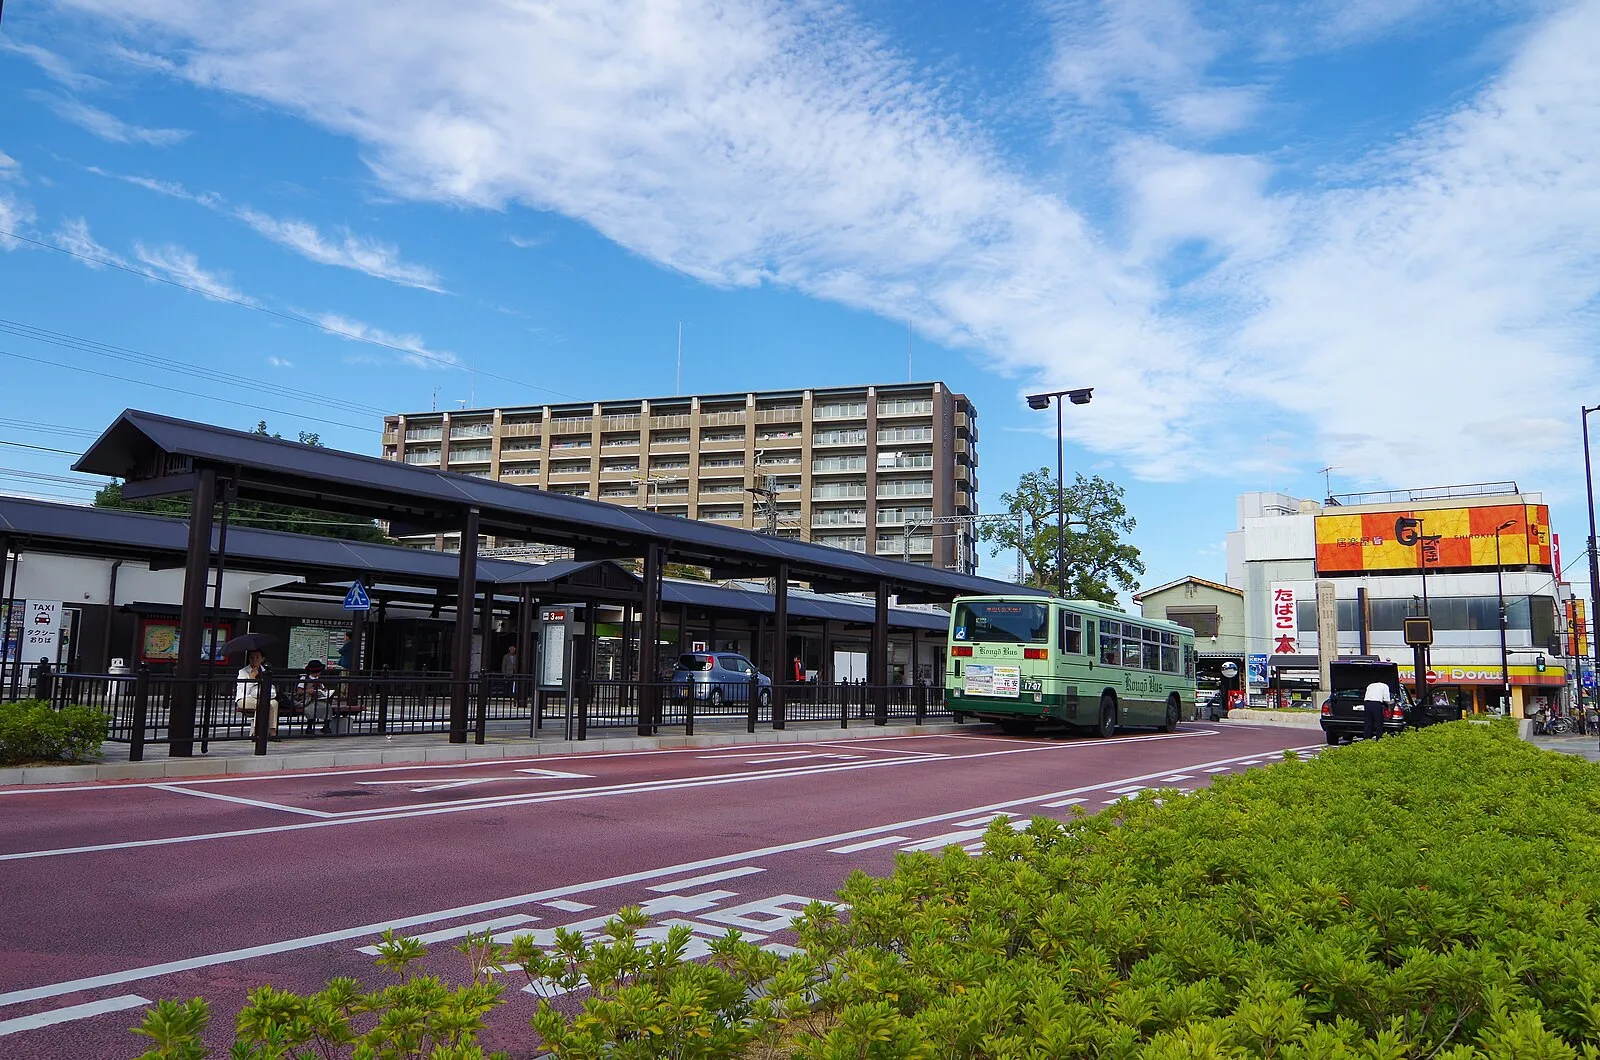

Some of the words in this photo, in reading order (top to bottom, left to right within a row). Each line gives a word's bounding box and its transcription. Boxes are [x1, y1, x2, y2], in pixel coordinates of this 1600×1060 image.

[33, 603, 55, 611] TAXI
[1274, 588, 1294, 629] たばこ
[1002, 647, 1018, 656] Bus
[1148, 675, 1163, 693] Bus
